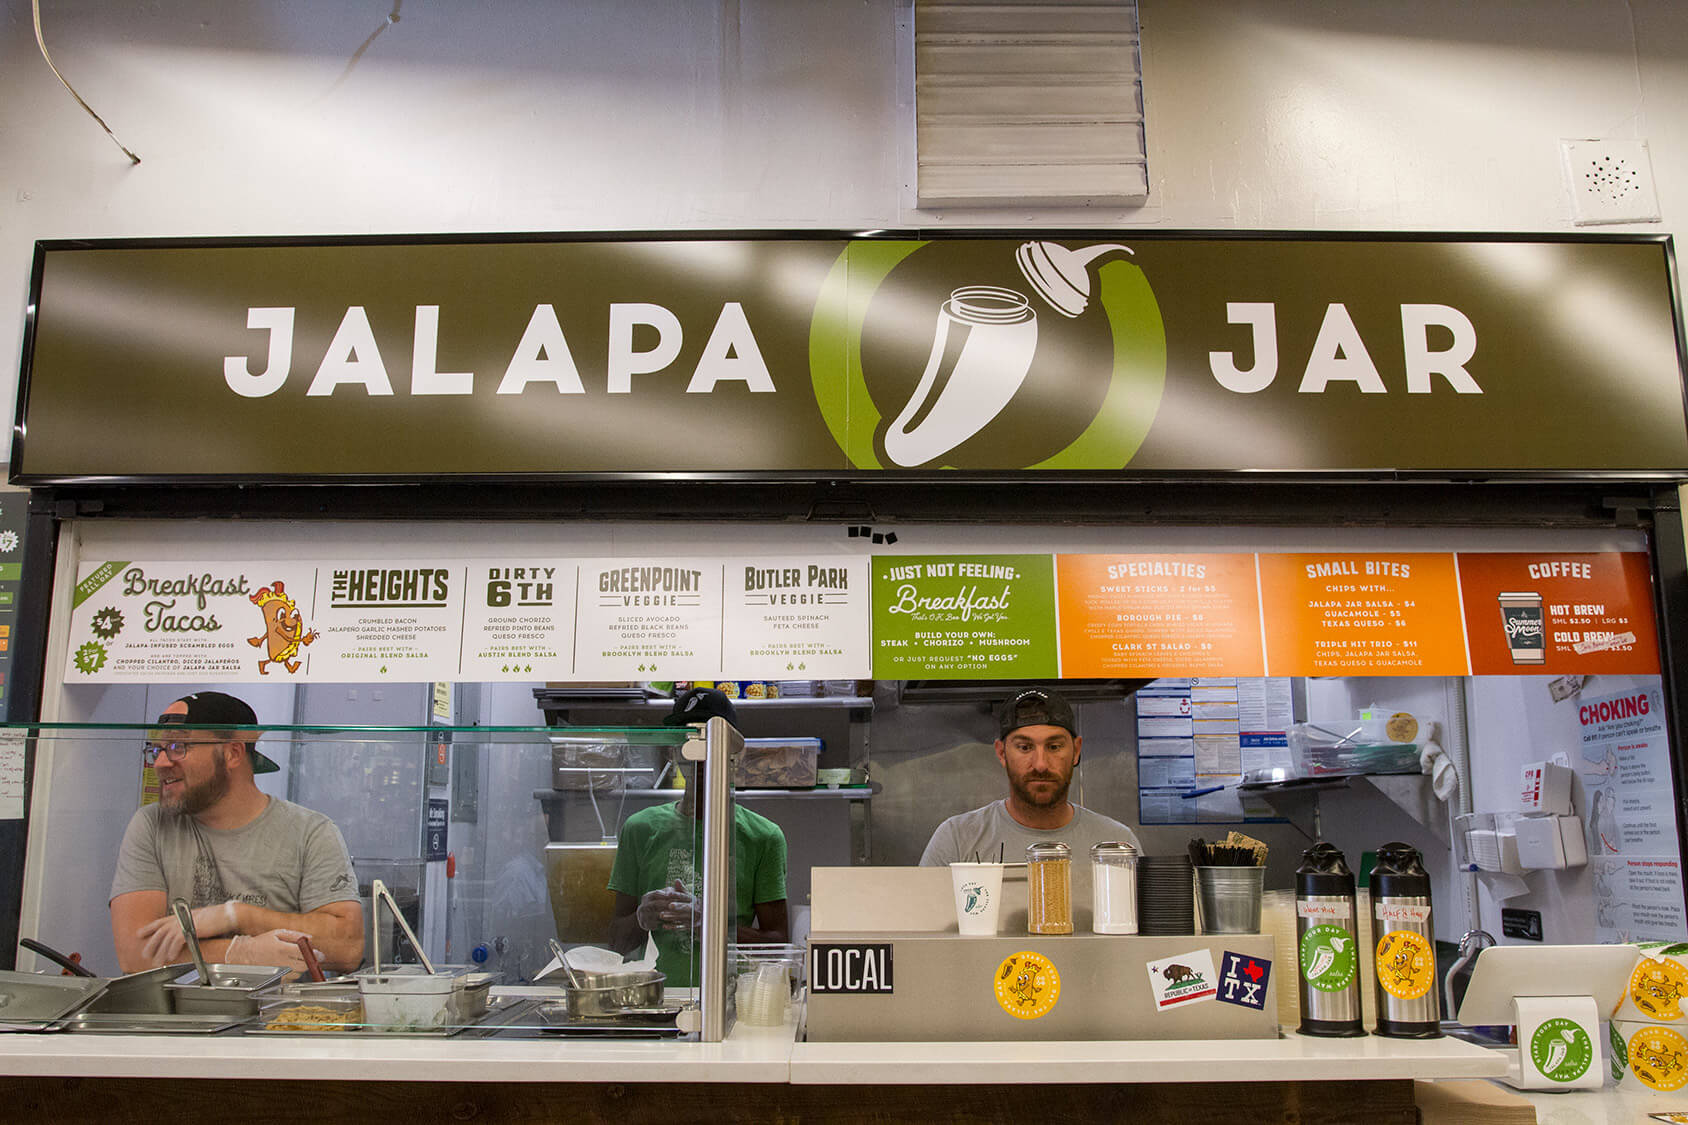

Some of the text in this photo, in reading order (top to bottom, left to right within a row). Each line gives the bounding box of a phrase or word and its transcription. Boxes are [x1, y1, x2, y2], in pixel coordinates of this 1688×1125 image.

[224, 301, 1484, 398] JALAPA JAR
[80, 563, 113, 592] FEATURED
[488, 568, 556, 580] DIRTY
[890, 563, 1015, 581] JUST NOT FEELING
[1107, 562, 1206, 580] SPECIALTIES
[1305, 561, 1411, 579] SMALL BITES
[1528, 562, 1592, 580] COFFEE
[331, 569, 449, 602] THE HEIGHTS
[599, 567, 702, 593] GREENPOINT
[123, 567, 252, 612] Breakfast
[486, 580, 553, 608] 6TH
[623, 595, 677, 607] VEGGIE
[769, 593, 824, 605] VEGGIE
[888, 584, 1011, 622] Breakfast
[143, 599, 223, 633] Tacos
[1549, 604, 1605, 616] HOT BREW
[96, 615, 113, 630] $4
[923, 639, 964, 647] CHORIZO
[1554, 631, 1615, 643] COLD BREW
[1112, 643, 1191, 651] CLARK ST SALAD
[1579, 694, 1650, 726] CHOKING
[813, 948, 892, 991] LOCAL
[1224, 955, 1261, 1005] I TX
[1164, 983, 1209, 999] REPUBLIC TEXAS
